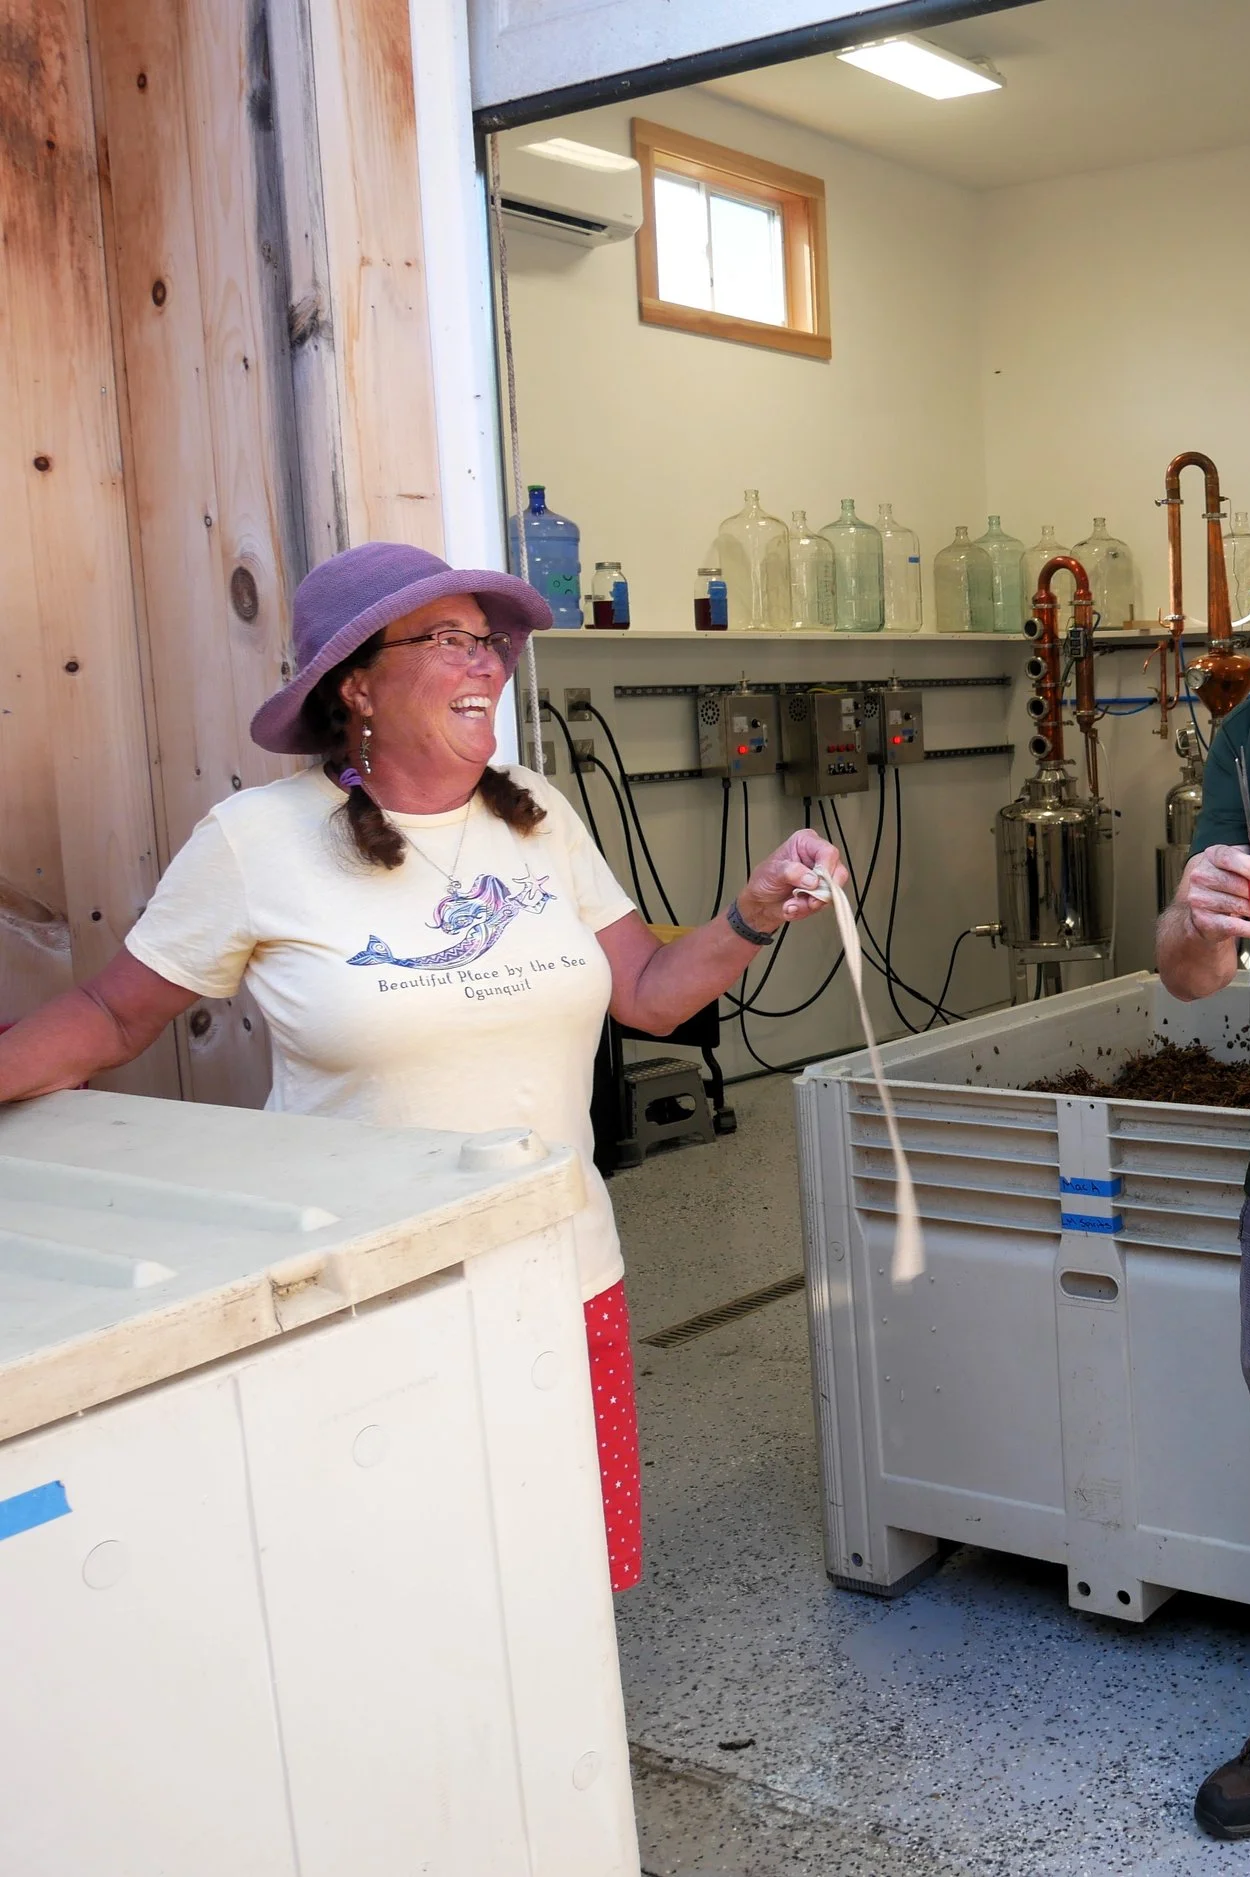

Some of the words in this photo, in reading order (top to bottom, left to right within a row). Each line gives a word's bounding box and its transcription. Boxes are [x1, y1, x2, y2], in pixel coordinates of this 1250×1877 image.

[378, 972, 453, 992] Beautiful
[457, 969, 500, 983] Place
[504, 964, 523, 977] by
[529, 960, 556, 972] the
[560, 955, 587, 968] Sea
[463, 978, 532, 1001] Ogunquit
